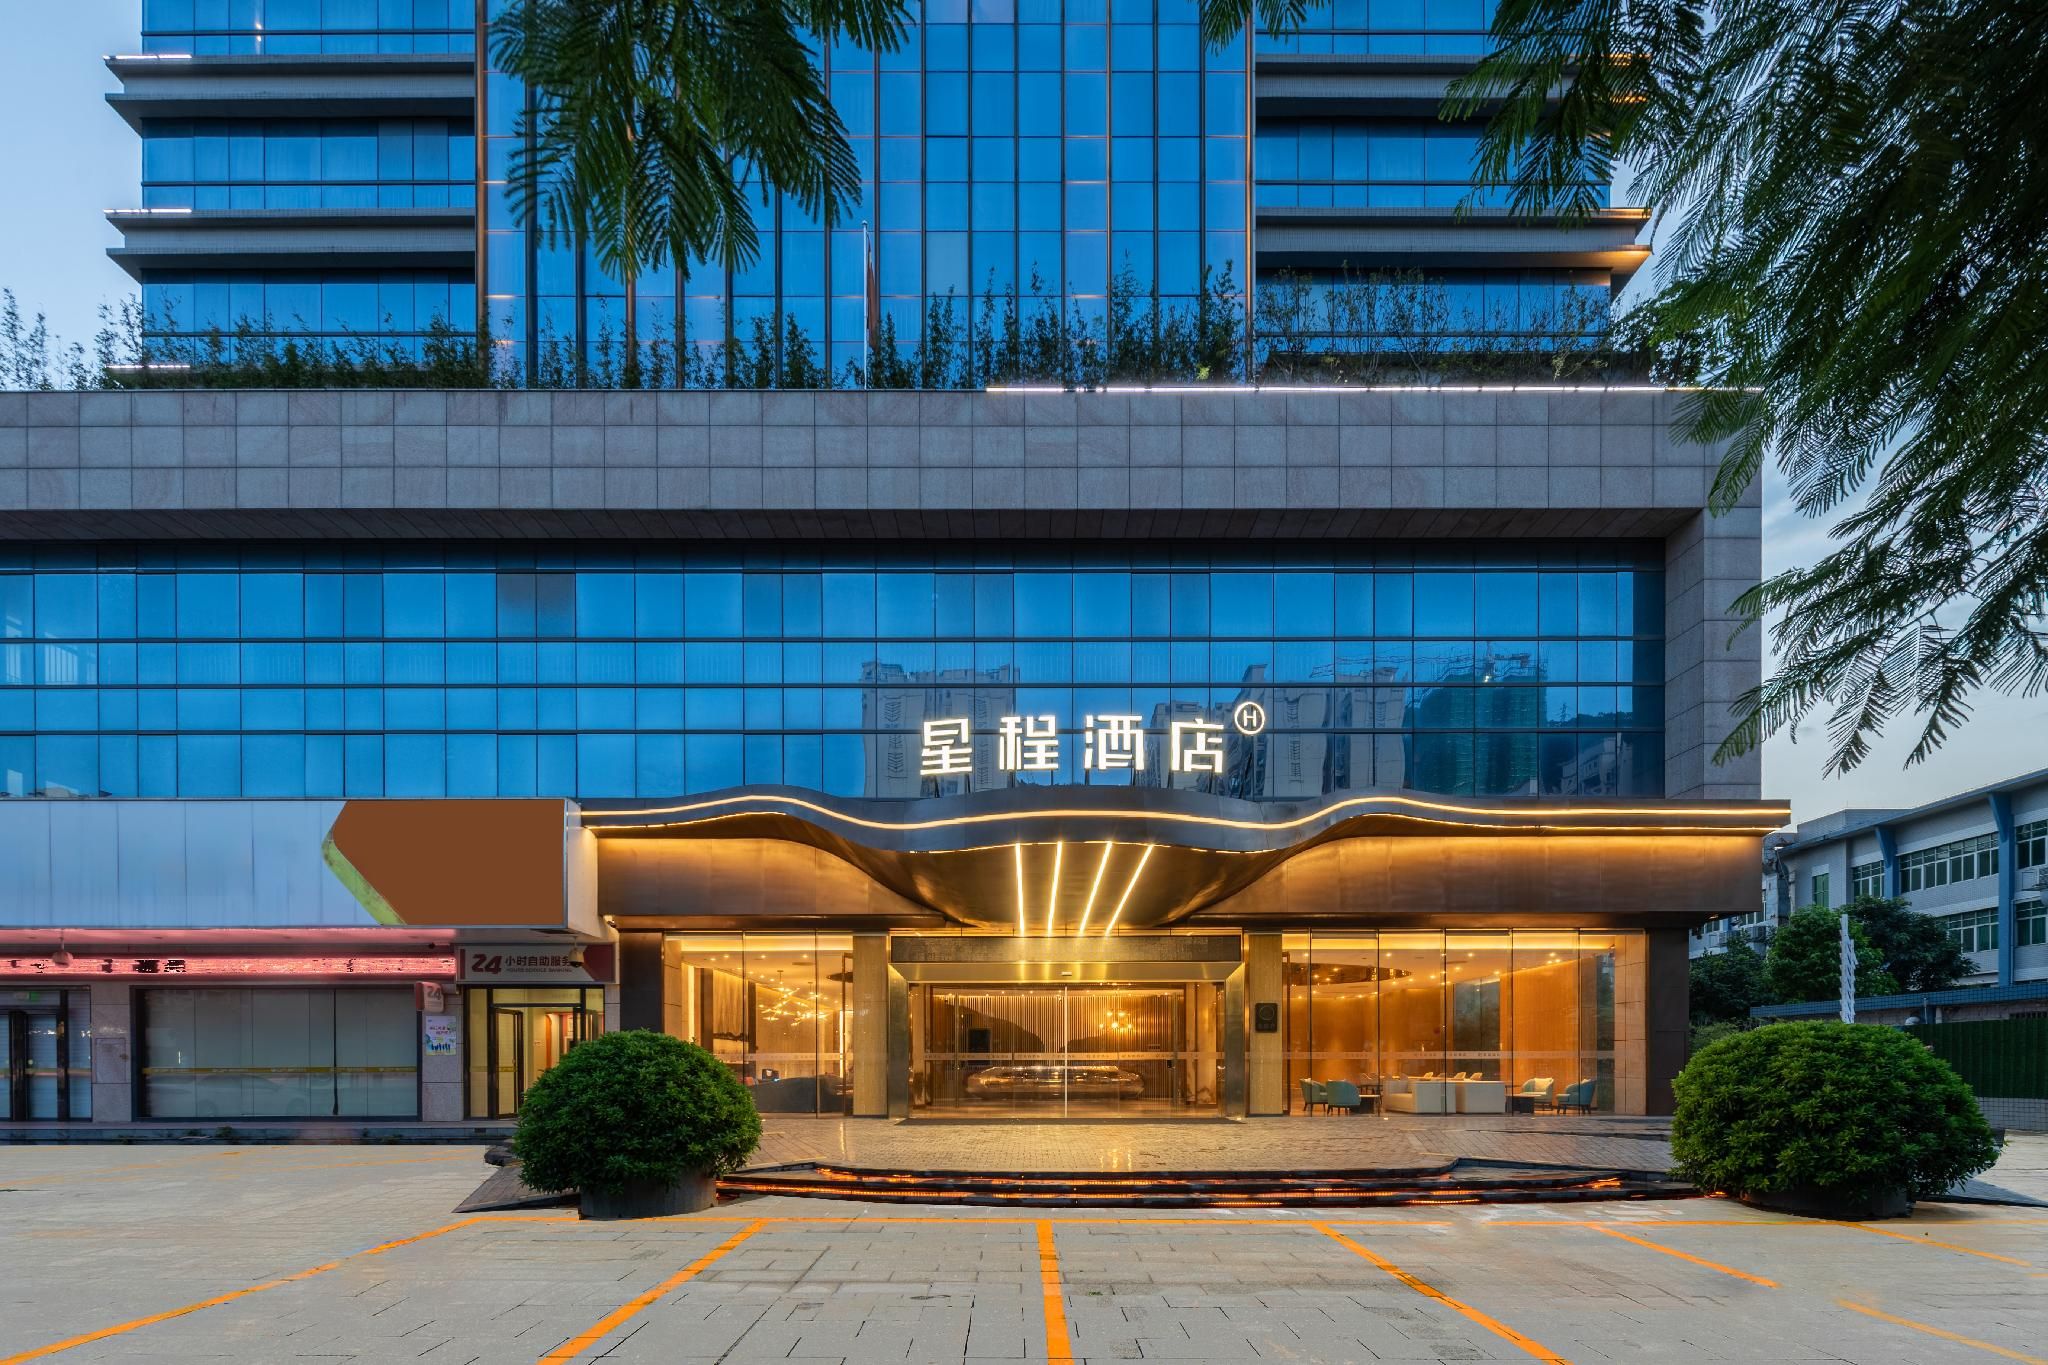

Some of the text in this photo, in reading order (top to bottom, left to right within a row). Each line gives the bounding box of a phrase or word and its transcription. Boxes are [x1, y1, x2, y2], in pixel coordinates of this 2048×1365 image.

[920, 714, 1224, 775] 星程酒店
[471, 953, 502, 974] 24
